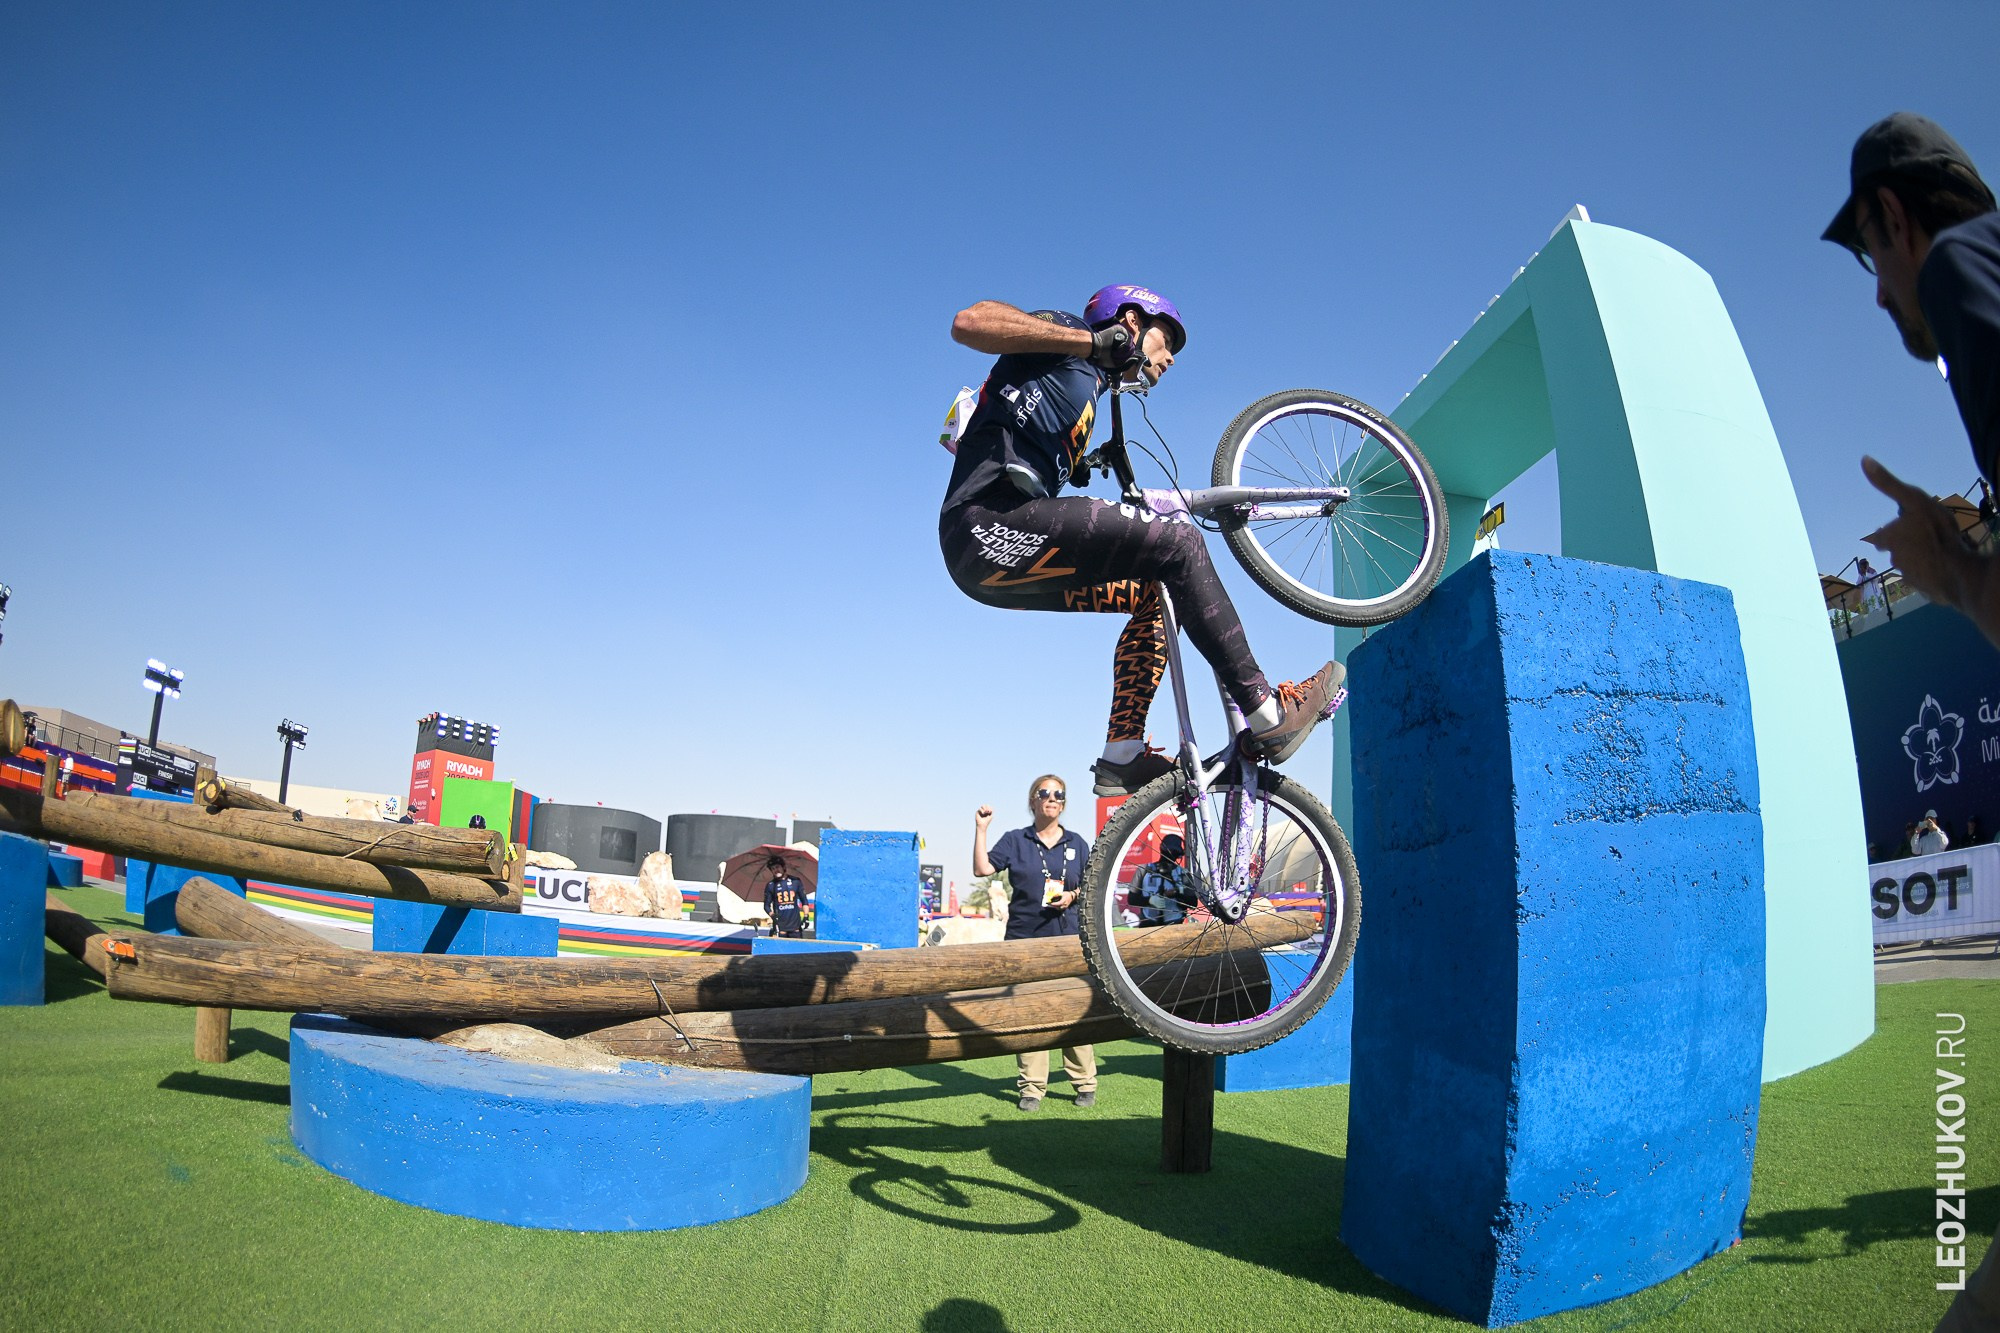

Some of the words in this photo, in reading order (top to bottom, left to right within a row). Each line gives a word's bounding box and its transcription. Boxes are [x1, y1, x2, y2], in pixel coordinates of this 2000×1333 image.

[1342, 401, 1383, 423] KENDA
[988, 522, 1049, 546] SCHOOL
[978, 545, 1021, 567] TRIAL
[140, 746, 151, 755] UCI
[157, 769, 173, 780] FINISH
[416, 759, 432, 771] RIYADH
[446, 760, 483, 777] RIYADH
[538, 876, 590, 904] UCI
[777, 891, 796, 903] ESP
[1871, 864, 1968, 919] SOT
